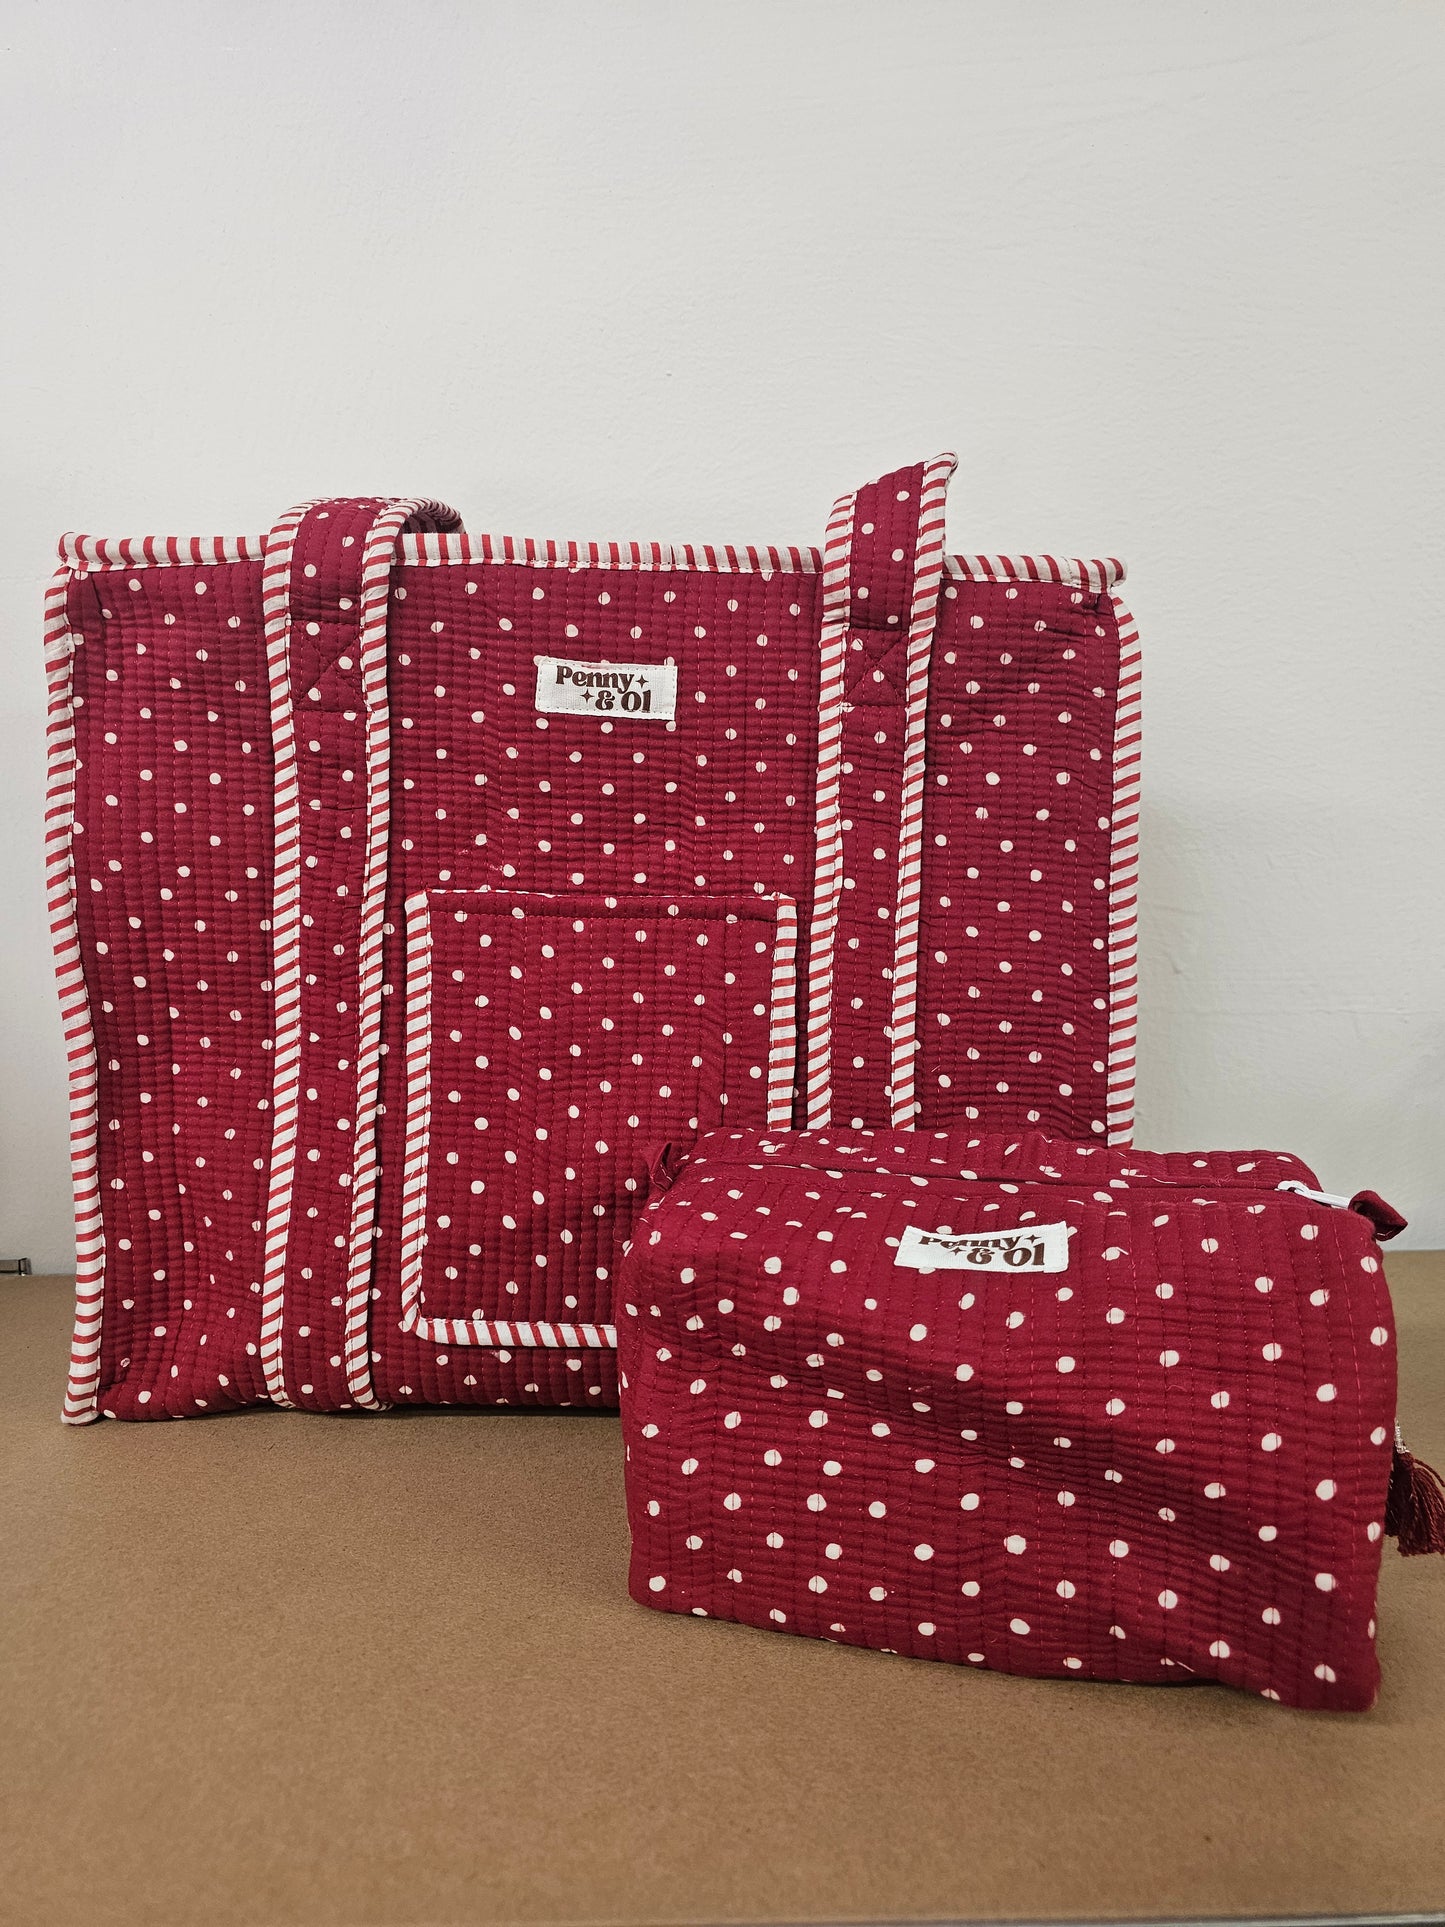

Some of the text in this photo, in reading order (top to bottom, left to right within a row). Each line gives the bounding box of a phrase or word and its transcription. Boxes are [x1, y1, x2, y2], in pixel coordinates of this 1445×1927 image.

[555, 665, 634, 694] Penny
[595, 690, 615, 710] &
[918, 1235, 1024, 1250] Penny
[966, 1248, 995, 1264] &
